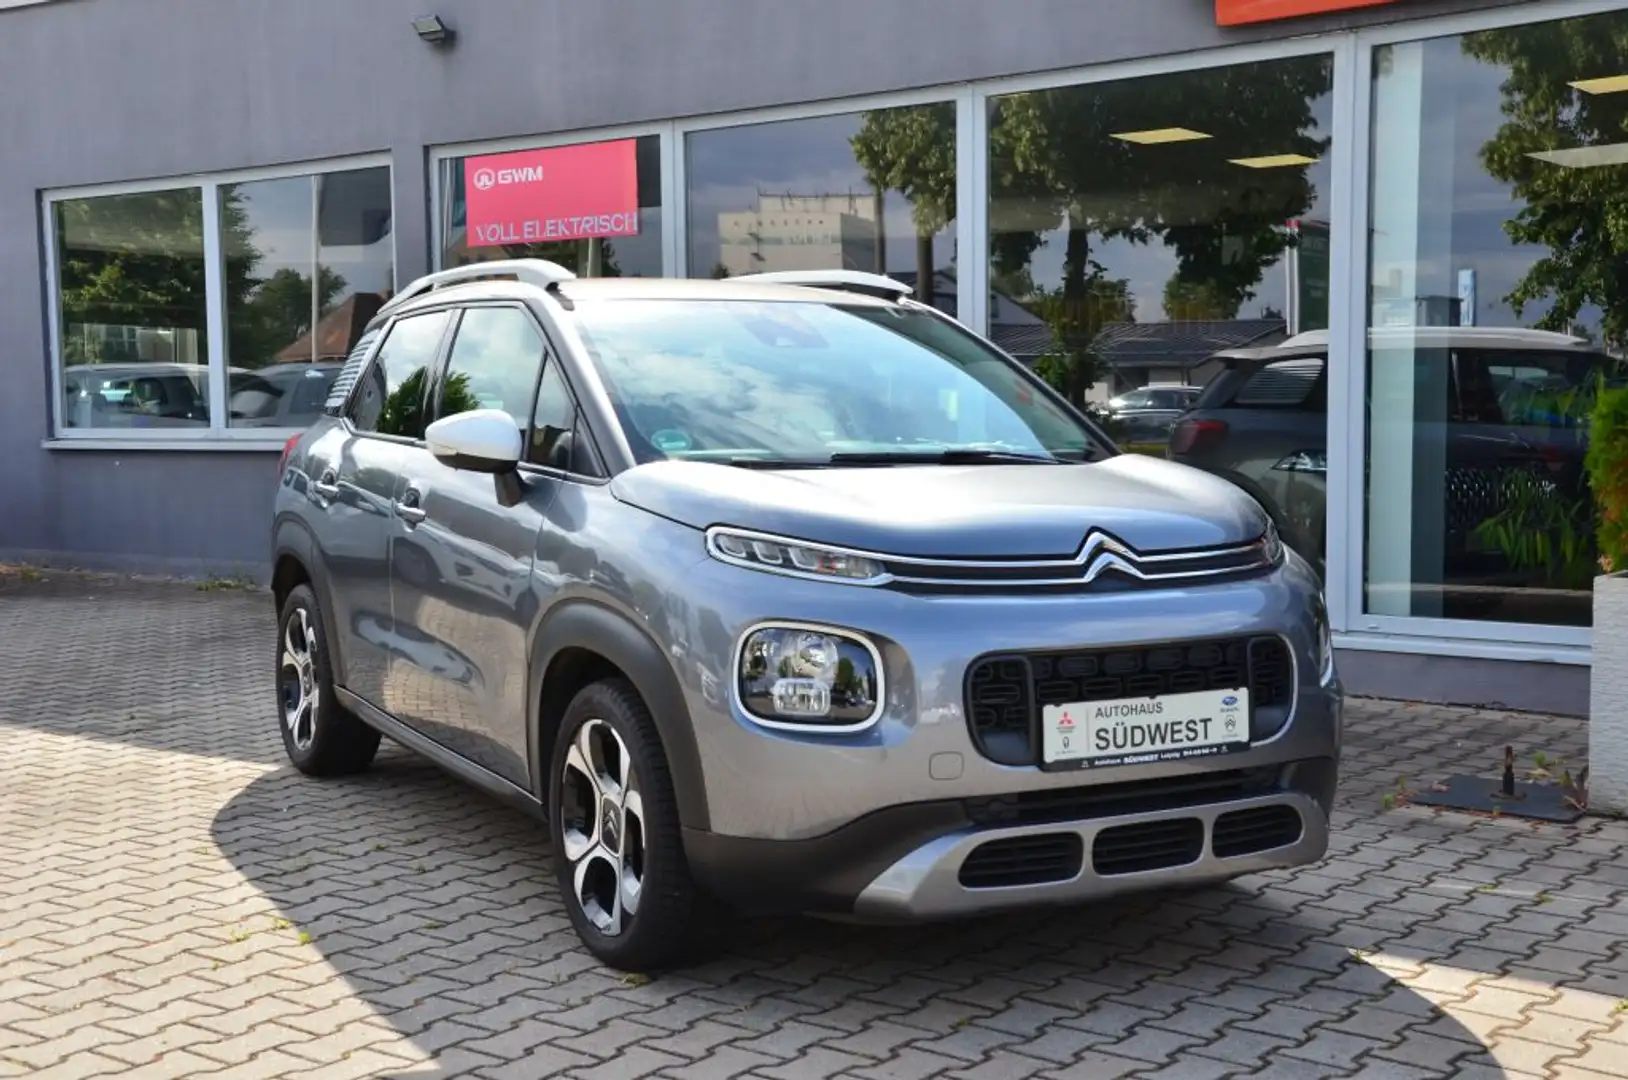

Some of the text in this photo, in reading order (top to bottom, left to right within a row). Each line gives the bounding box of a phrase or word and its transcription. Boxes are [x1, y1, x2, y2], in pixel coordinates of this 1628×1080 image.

[498, 165, 544, 185] GWM
[476, 212, 638, 242] VOLL ELEKTRISCH
[1095, 702, 1164, 719] AUTOHAUS
[1095, 718, 1213, 751] SÜDWEST
